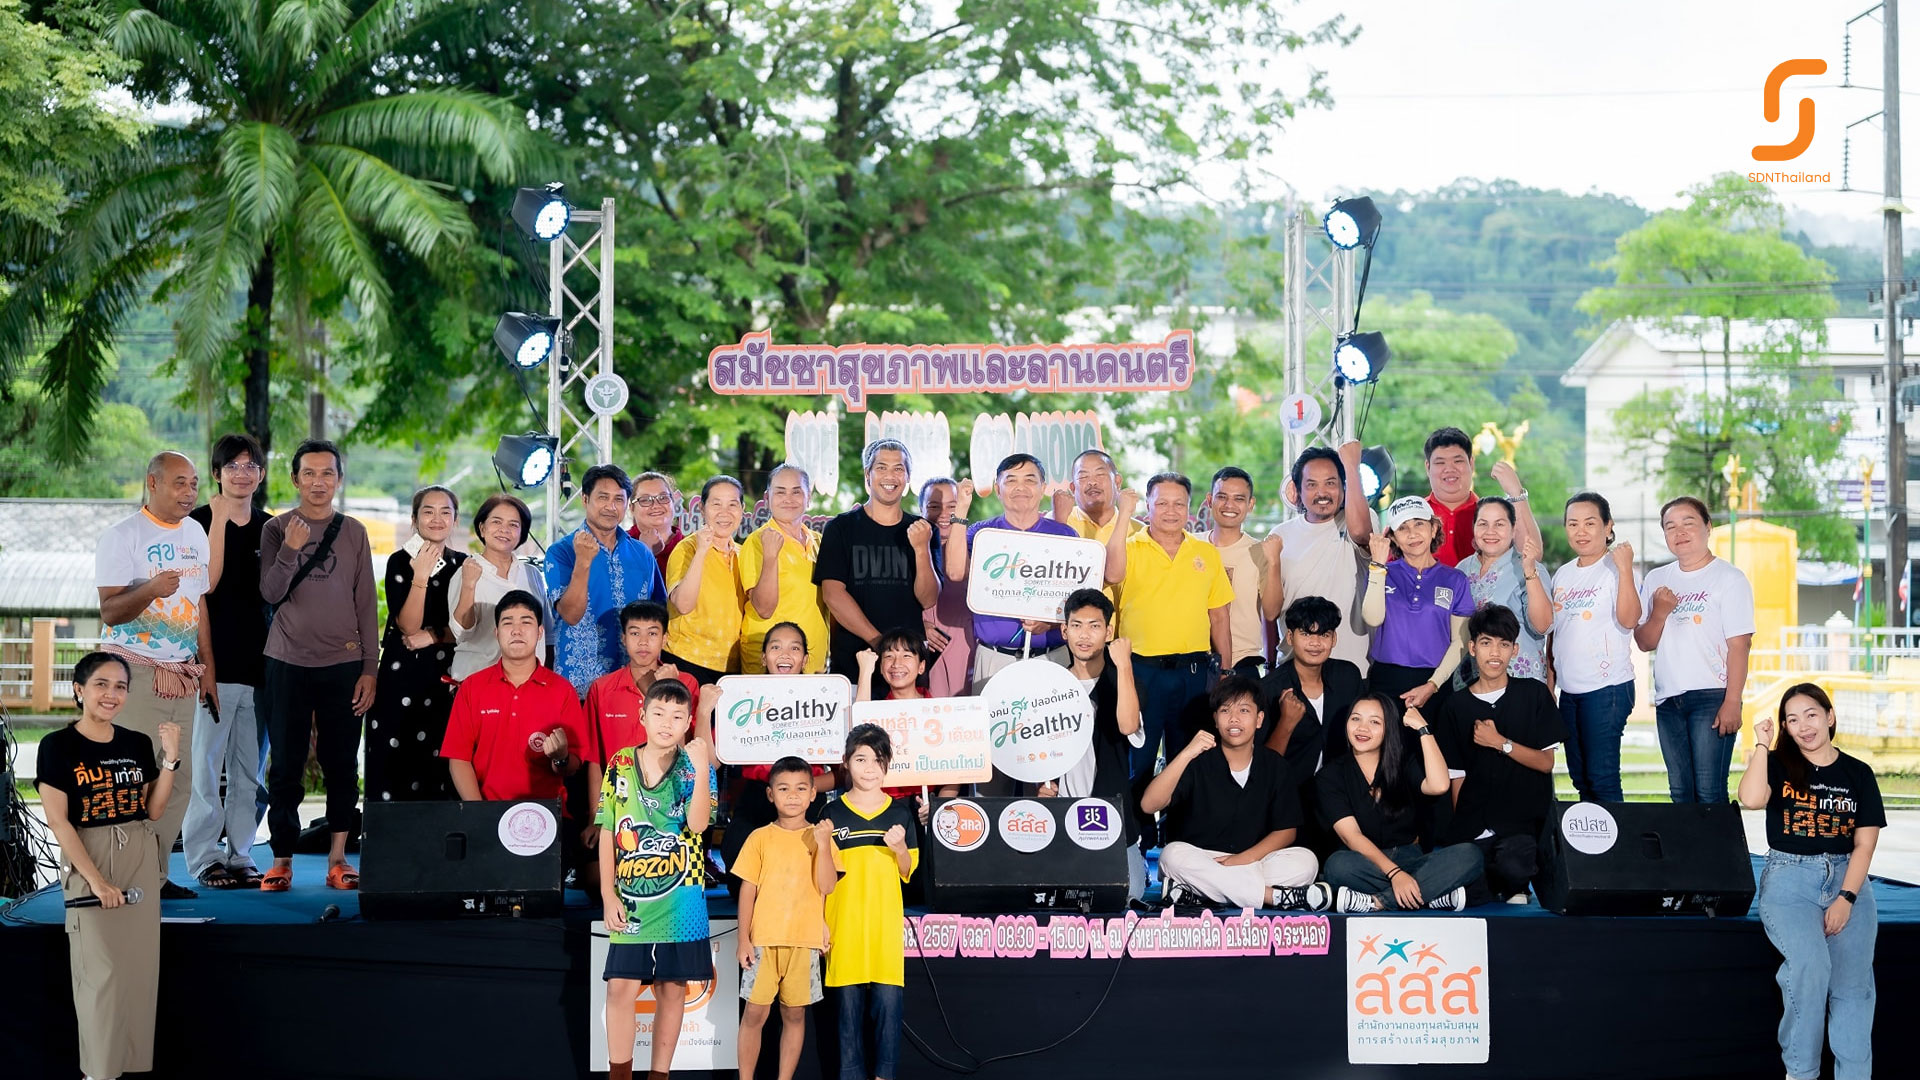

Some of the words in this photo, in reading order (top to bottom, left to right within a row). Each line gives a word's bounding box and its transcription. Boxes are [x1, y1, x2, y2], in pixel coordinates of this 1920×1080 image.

[714, 337, 1190, 403] สมัชชาสุขภาพและลานดนตรี
[982, 551, 1091, 584] Healthy
[727, 695, 838, 727] Healthy
[924, 719, 945, 746] 3
[989, 712, 1083, 748] Healthy
[914, 753, 985, 772] เป็นคนใหม่
[1007, 818, 1048, 834] สสส
[923, 924, 958, 948] 2567
[962, 926, 991, 947] เวลา
[997, 926, 1035, 949] 08.30
[1051, 926, 1086, 949] 15.00
[1226, 920, 1269, 947] อ.เมือง
[1274, 924, 1326, 946] จ.ระนอง
[1355, 966, 1482, 1015] สสส
[1357, 1020, 1479, 1033] สำนักงานกองทุนสนับสนุน
[1357, 1030, 1480, 1048] การสร้างเสริมสุขภาพ
